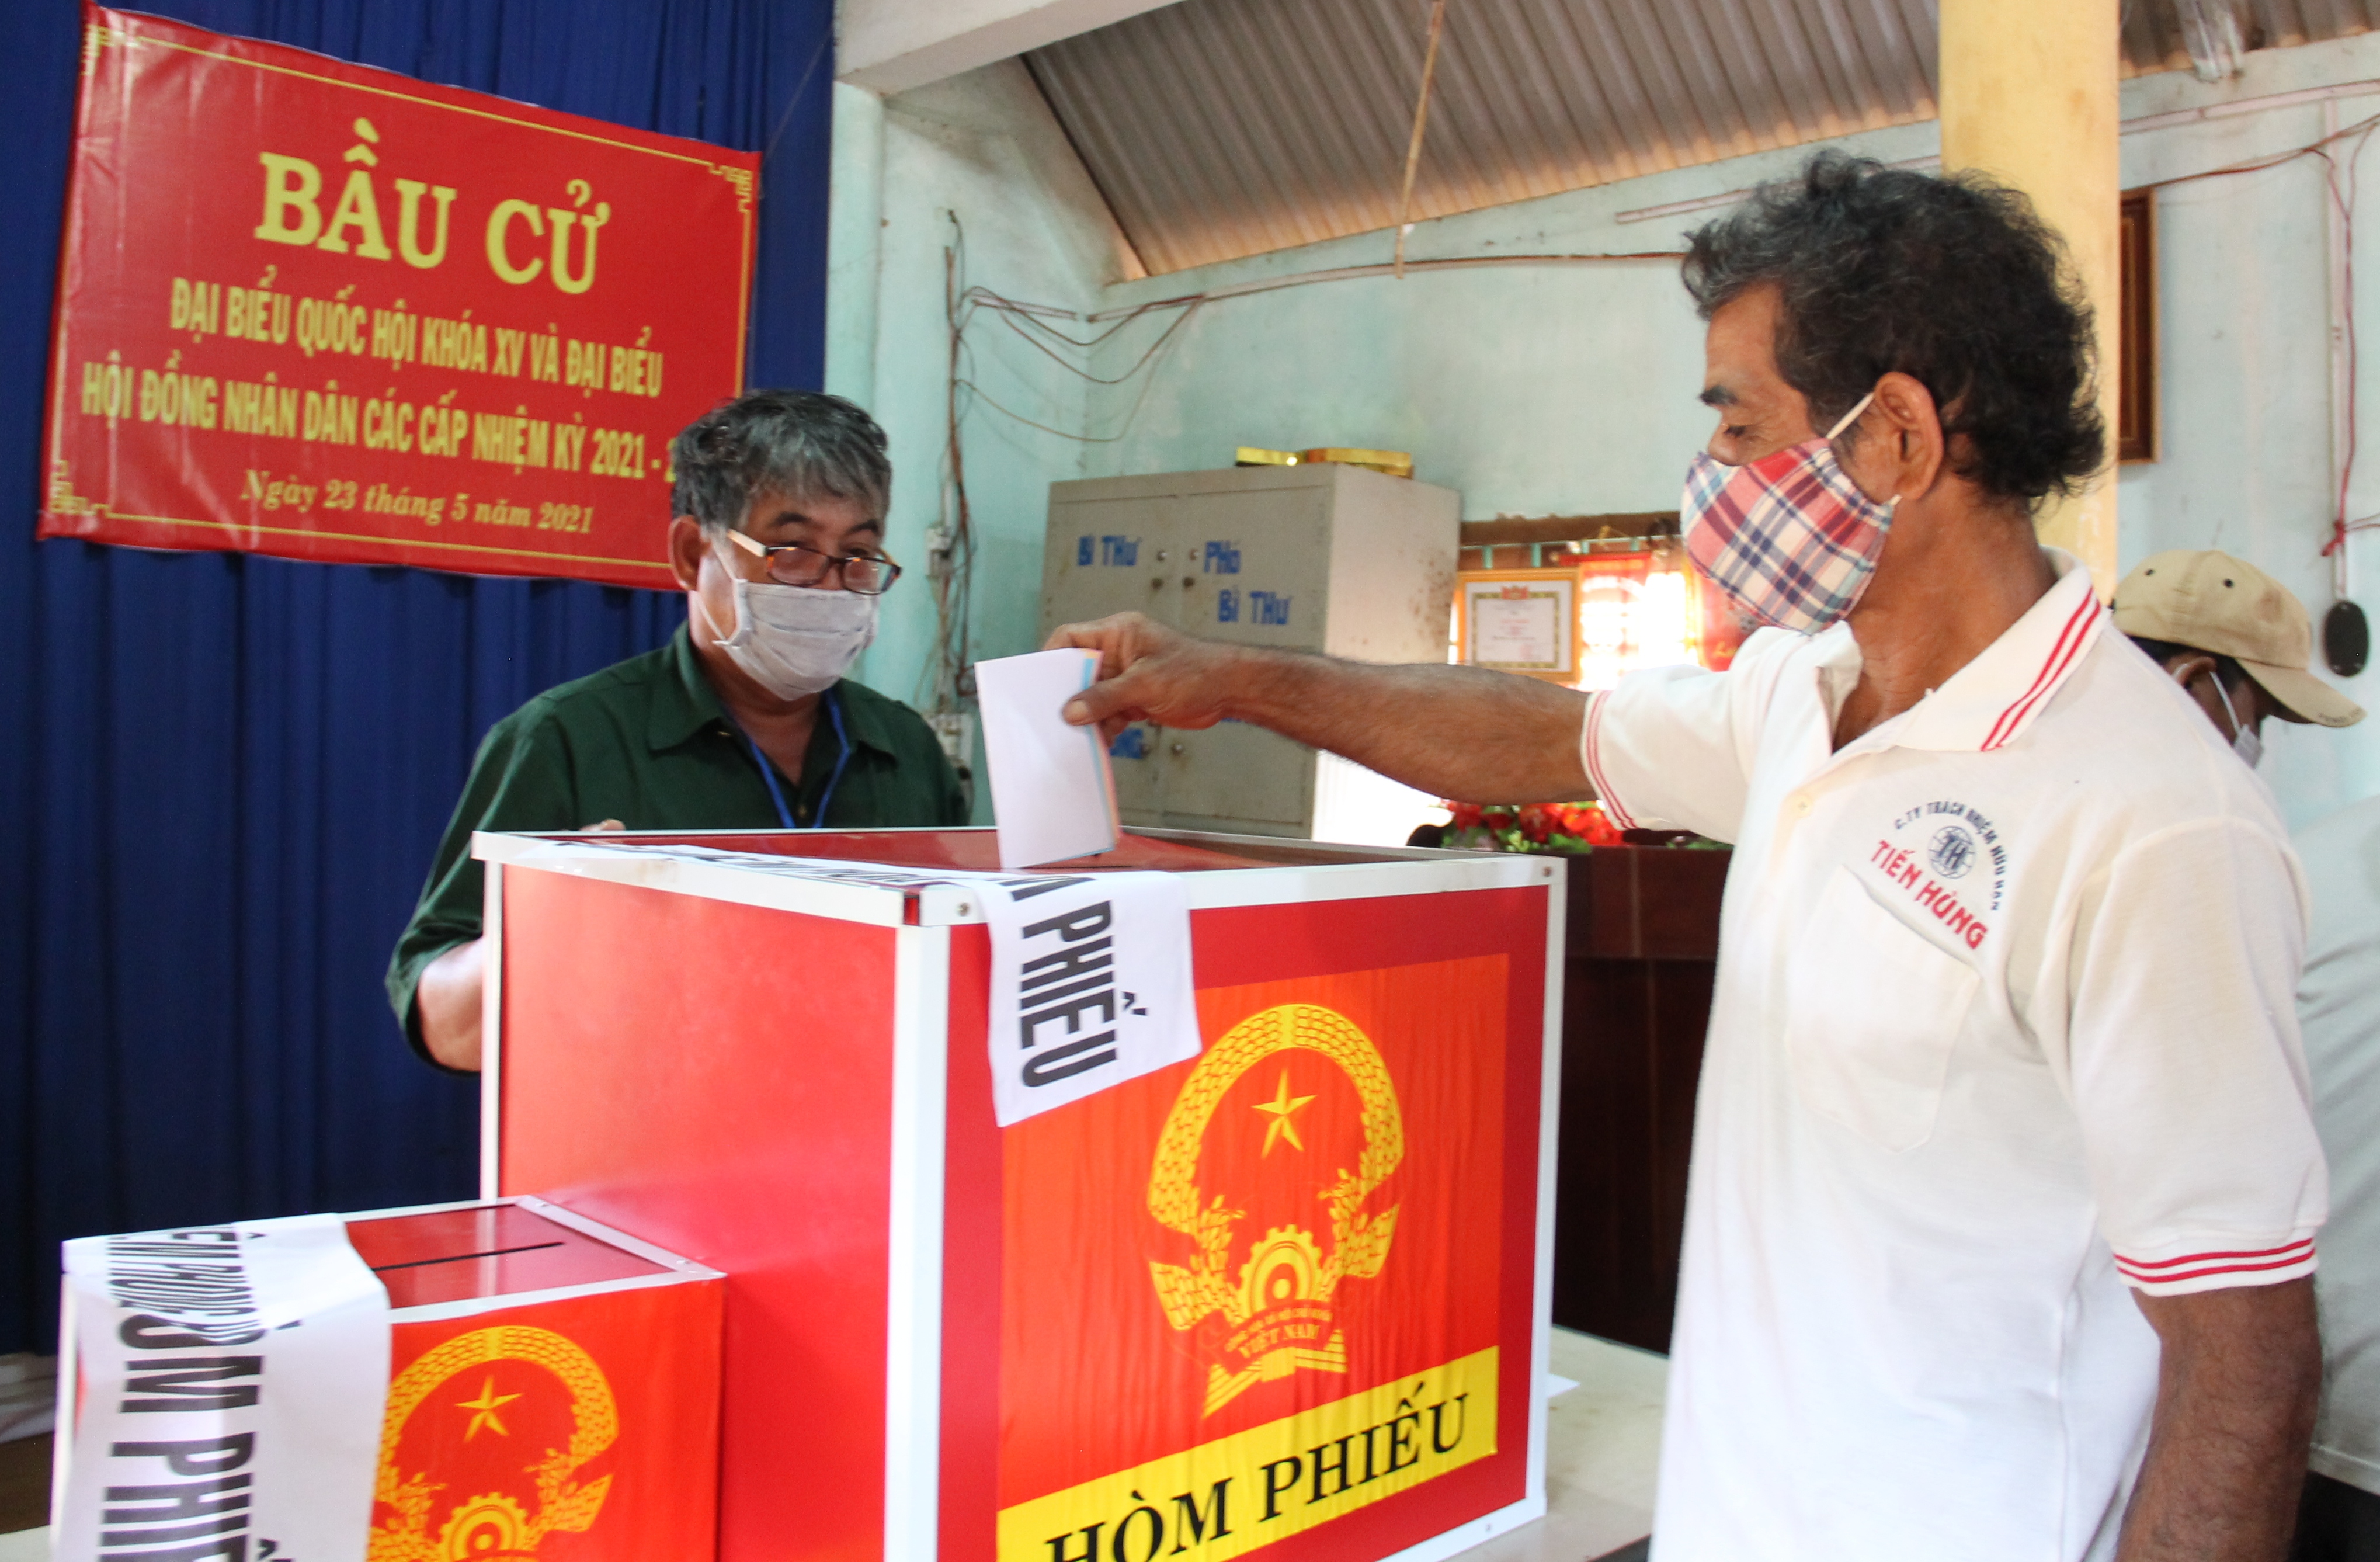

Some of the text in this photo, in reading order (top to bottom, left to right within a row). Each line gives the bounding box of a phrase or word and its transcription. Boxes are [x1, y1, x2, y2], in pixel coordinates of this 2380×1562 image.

[255, 118, 611, 294] BẦU CỬ
[171, 265, 663, 398] ĐẠI BIỂU QUỐC HỘI KHÓA XV VÀ ĐẠI BIỂU
[82, 350, 134, 429] HỘI
[140, 349, 218, 429] ĐỒNG
[222, 371, 299, 438] NHÂN
[301, 379, 359, 445] DÂN
[363, 387, 414, 453] CÁC
[419, 389, 468, 457] CẤP
[472, 405, 550, 475] NHIỆM
[553, 412, 586, 471] KỲ
[590, 428, 645, 478] 2021
[241, 469, 593, 533] Ngày 23 tháng 5 năm 2021
[1870, 839, 1923, 890] TIẾN
[1020, 900, 1148, 1087] PHIẾU
[1259, 1381, 1469, 1523] PHIẾU
